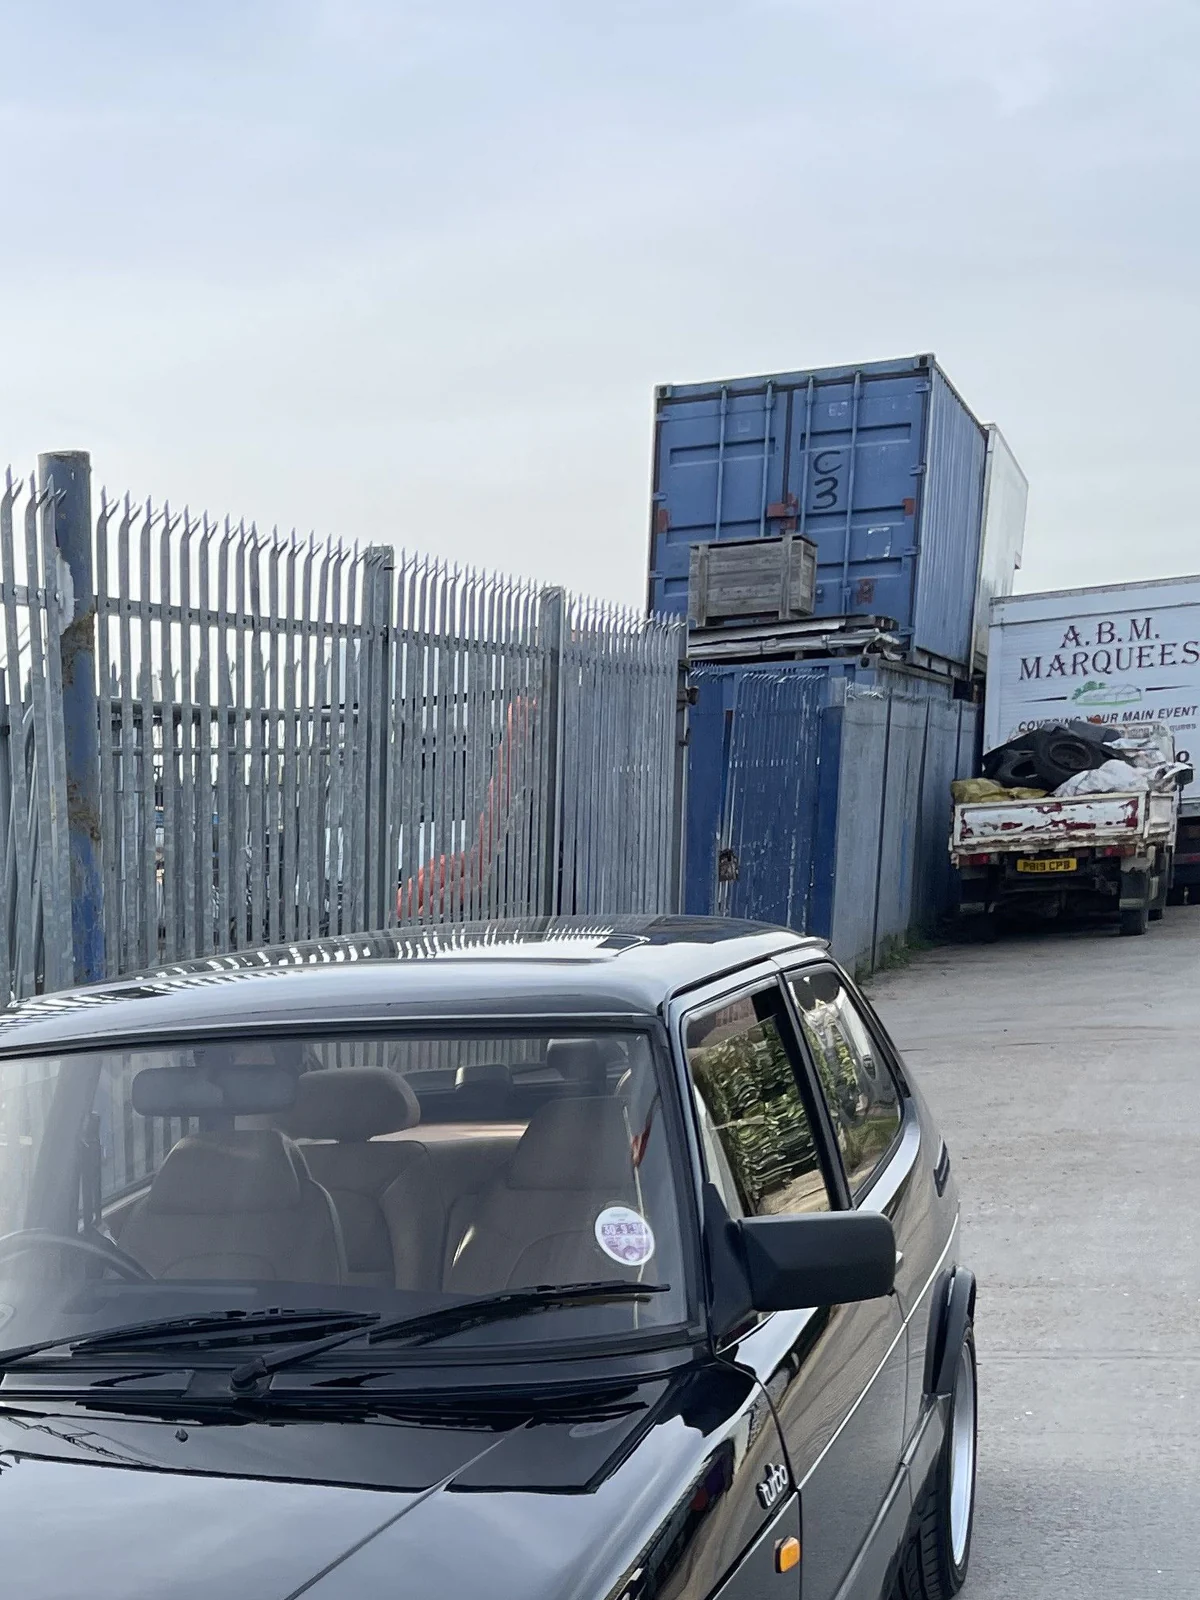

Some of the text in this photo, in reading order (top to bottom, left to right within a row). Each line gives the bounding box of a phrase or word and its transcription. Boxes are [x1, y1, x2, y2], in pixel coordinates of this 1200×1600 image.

[1059, 617, 1160, 649] A.B.M.
[1019, 641, 1200, 681] MARQUEES
[1122, 710, 1156, 722] MAIN
[1157, 705, 1199, 719] EVENT
[757, 1463, 789, 1508] turbo
